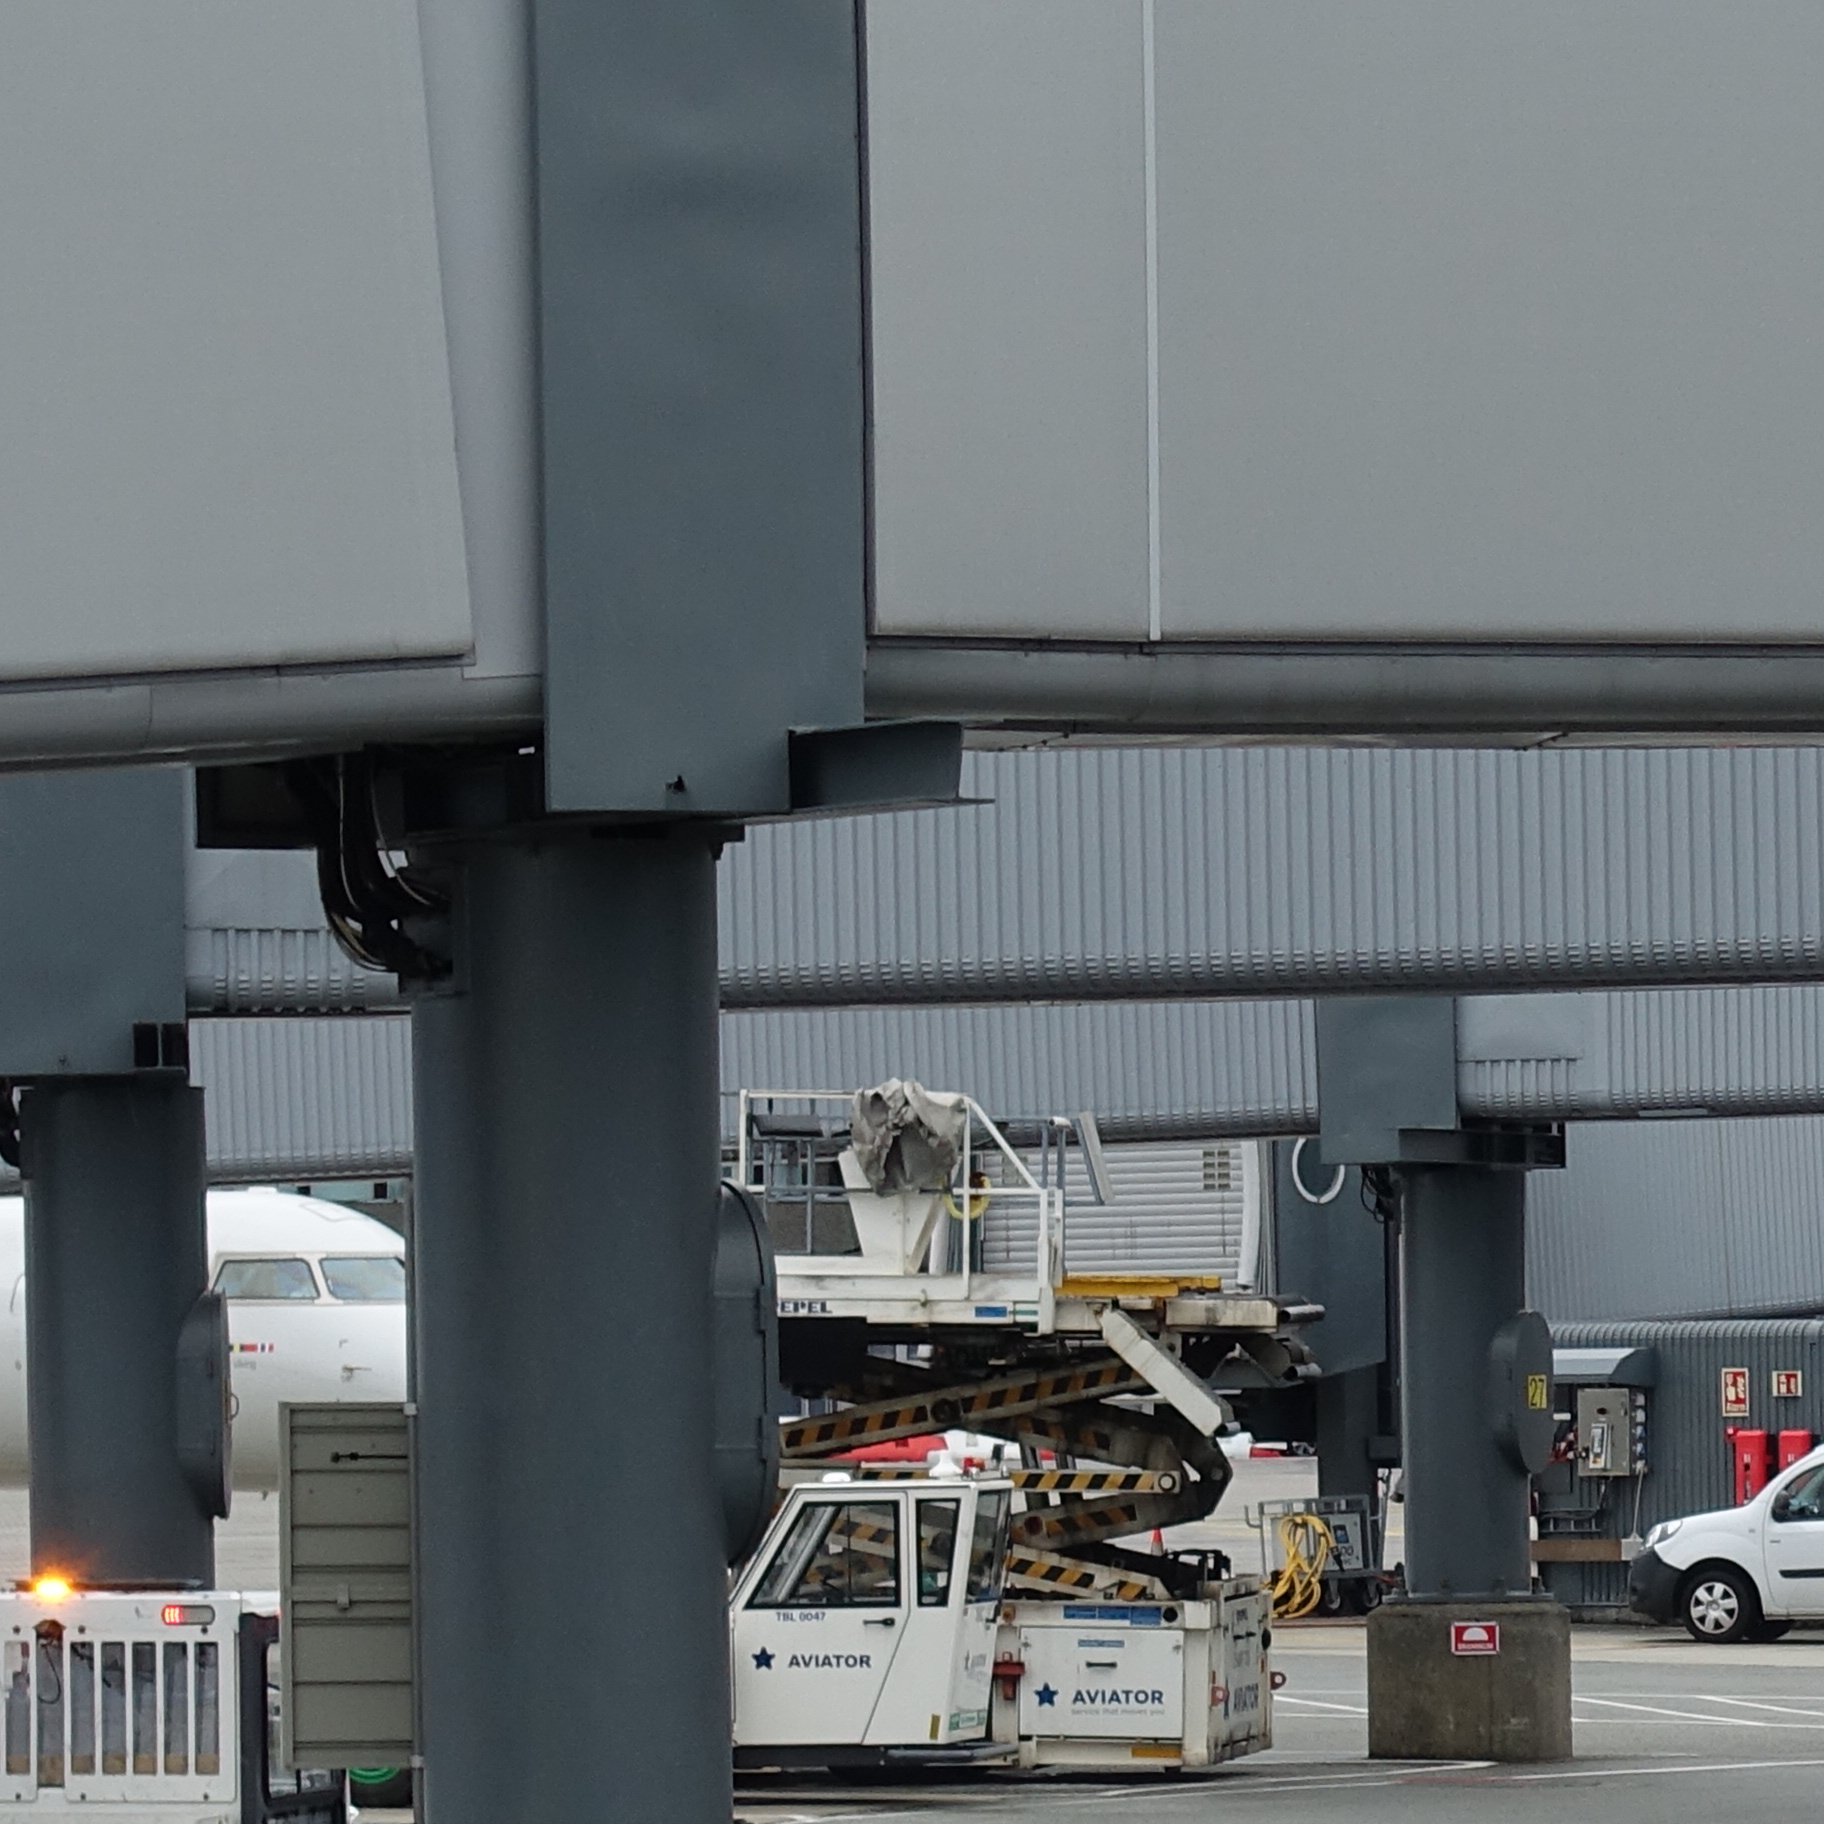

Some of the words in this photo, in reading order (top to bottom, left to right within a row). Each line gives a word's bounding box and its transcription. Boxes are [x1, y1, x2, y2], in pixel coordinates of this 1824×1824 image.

[1530, 1378, 1544, 1407] 27
[788, 1655, 871, 1668] AVIATOR
[1072, 1689, 1164, 1704] AVIATOR
